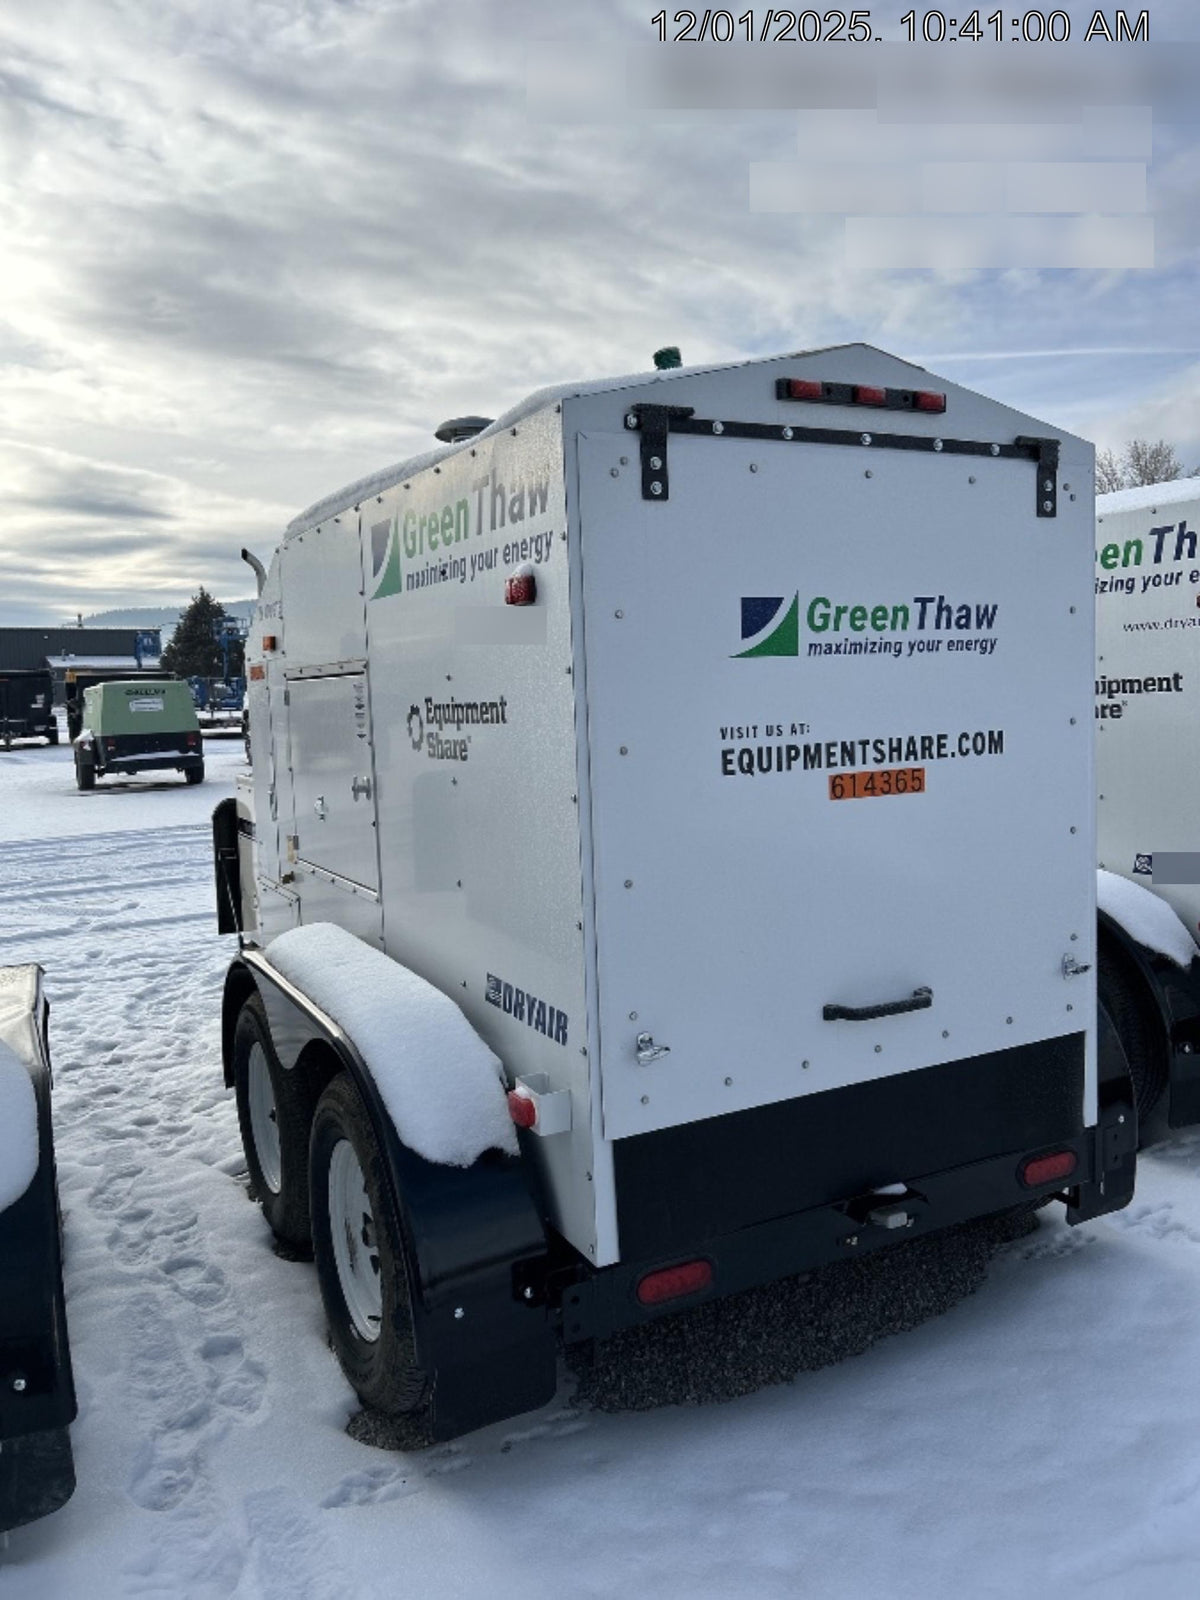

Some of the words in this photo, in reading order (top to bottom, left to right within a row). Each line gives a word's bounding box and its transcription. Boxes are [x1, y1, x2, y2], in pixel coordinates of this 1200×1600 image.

[402, 467, 550, 559] GreenThaw
[406, 555, 467, 591] maximizing
[470, 547, 499, 582] your
[502, 530, 554, 565] energy
[1095, 520, 1198, 570] enTh
[1141, 570, 1184, 594] your
[806, 594, 999, 633] GreenThaw
[807, 637, 903, 658] maximizing
[907, 638, 943, 657] your
[946, 636, 998, 656] energy
[424, 695, 507, 731] Equipment
[720, 725, 758, 740] VISIT
[765, 724, 784, 737] US
[790, 723, 811, 736] AT:
[720, 730, 1005, 778] EQUIPMENTSHARE.COM
[830, 768, 924, 800] 614365
[501, 981, 569, 1047] DRYAIR
